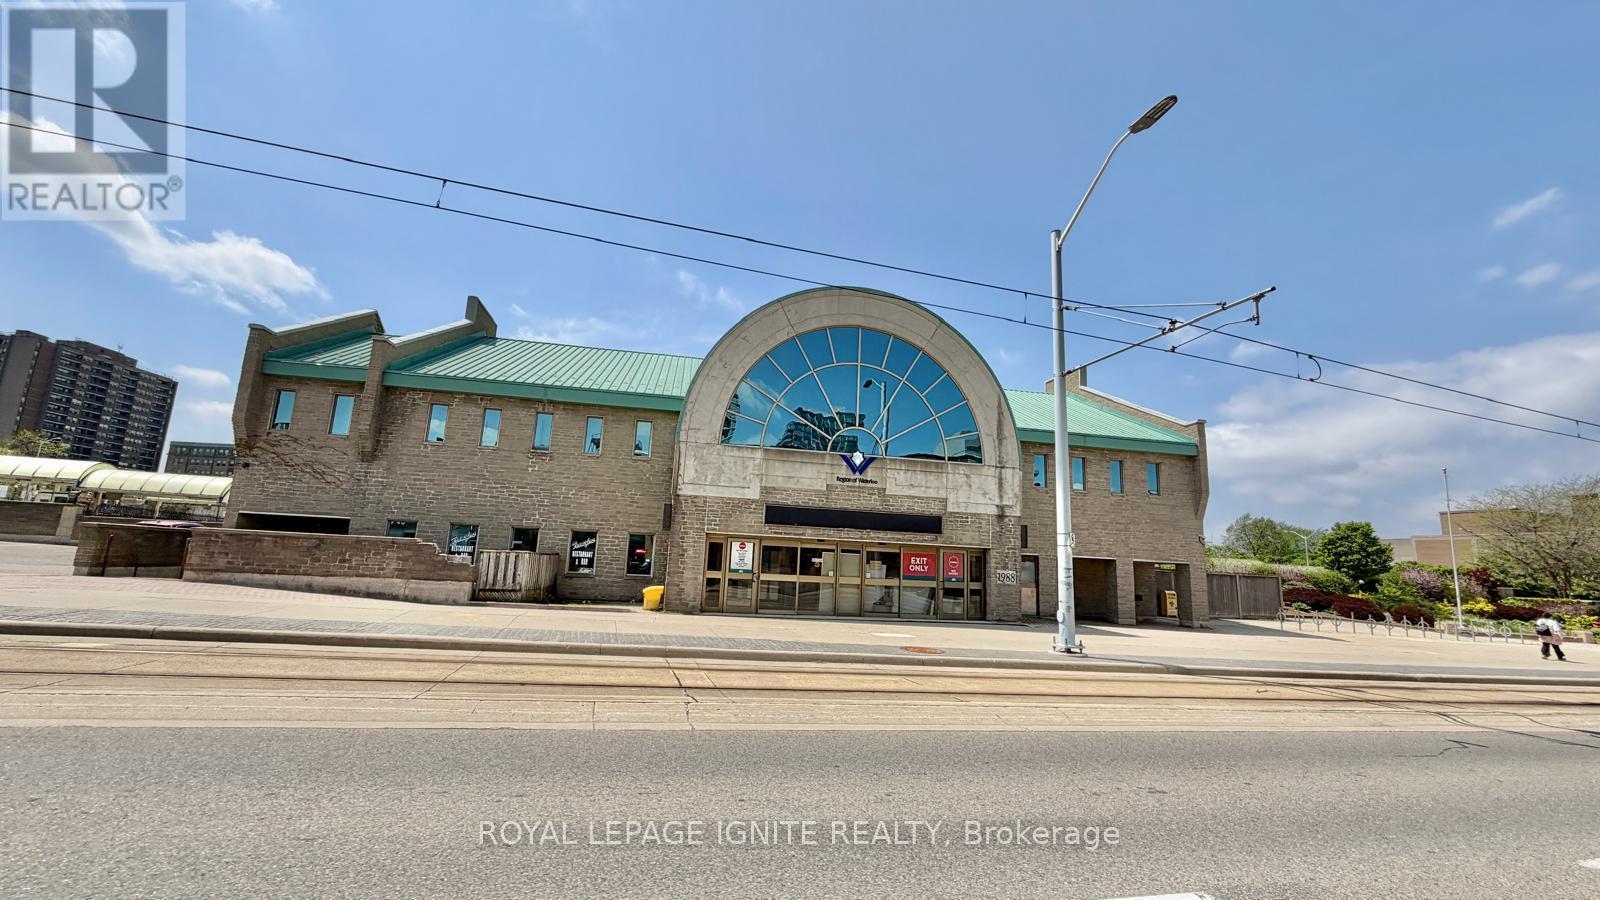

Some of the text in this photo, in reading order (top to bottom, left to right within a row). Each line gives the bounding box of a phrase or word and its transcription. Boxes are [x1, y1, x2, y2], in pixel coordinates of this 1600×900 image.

[910, 556, 928, 565] EXIT
[909, 564, 929, 572] ONLY
[998, 572, 1016, 583] 1988
